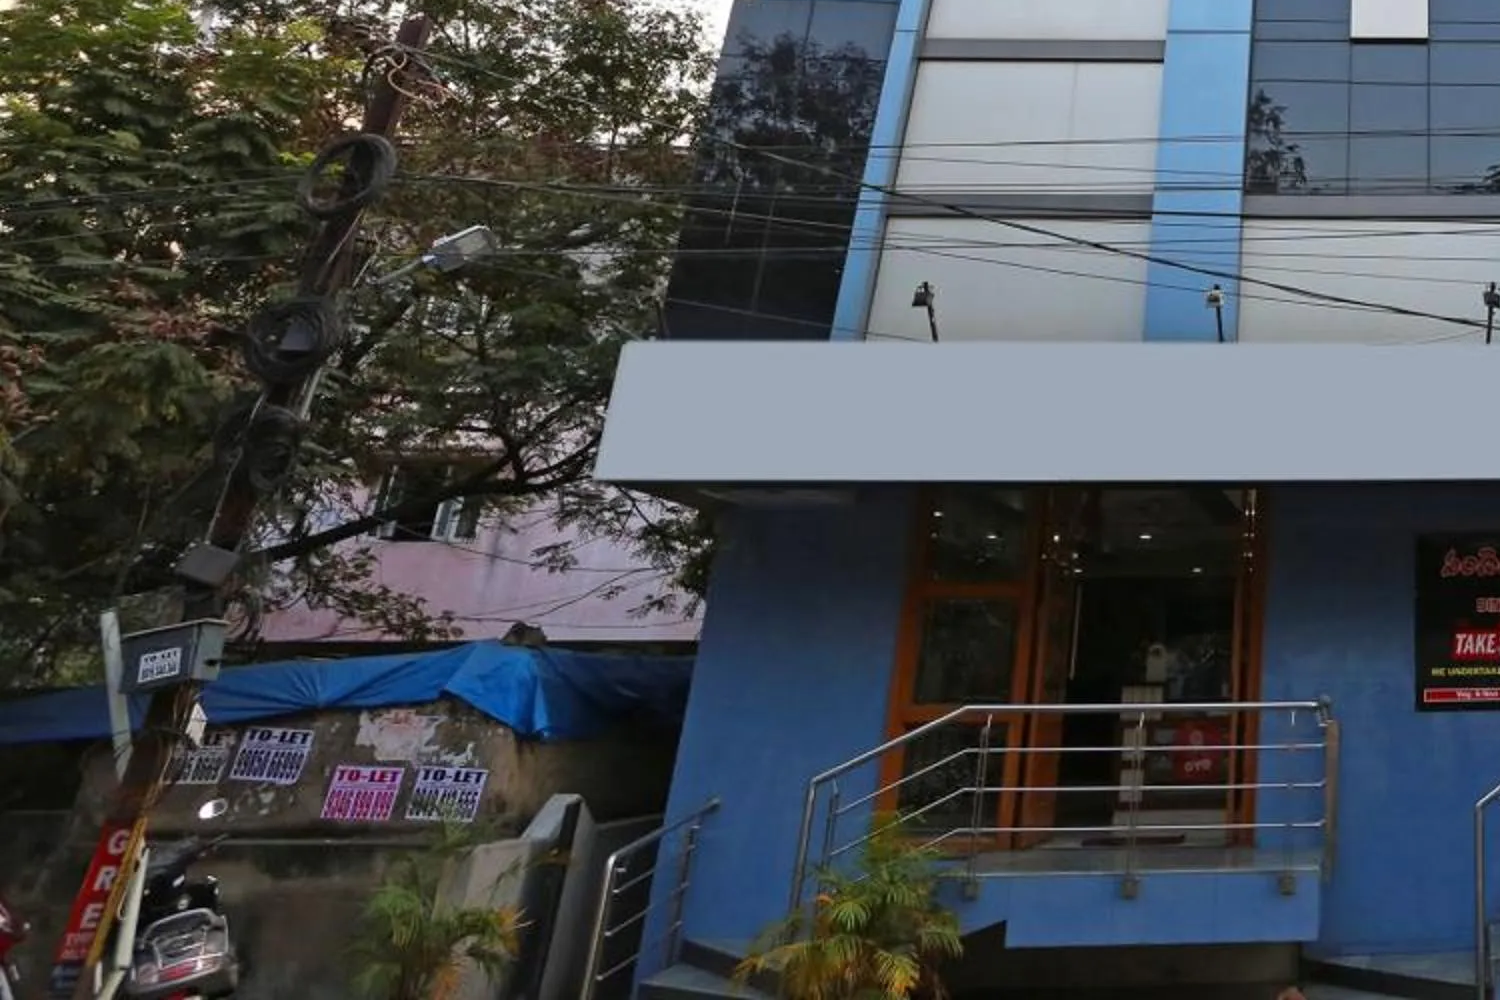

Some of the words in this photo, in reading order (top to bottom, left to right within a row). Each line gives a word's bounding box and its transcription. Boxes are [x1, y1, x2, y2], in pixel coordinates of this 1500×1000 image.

[1455, 633, 1497, 655] TAKE
[249, 729, 312, 744] TO-LET
[337, 769, 401, 783] TO-LET
[422, 769, 485, 783] TO-LET
